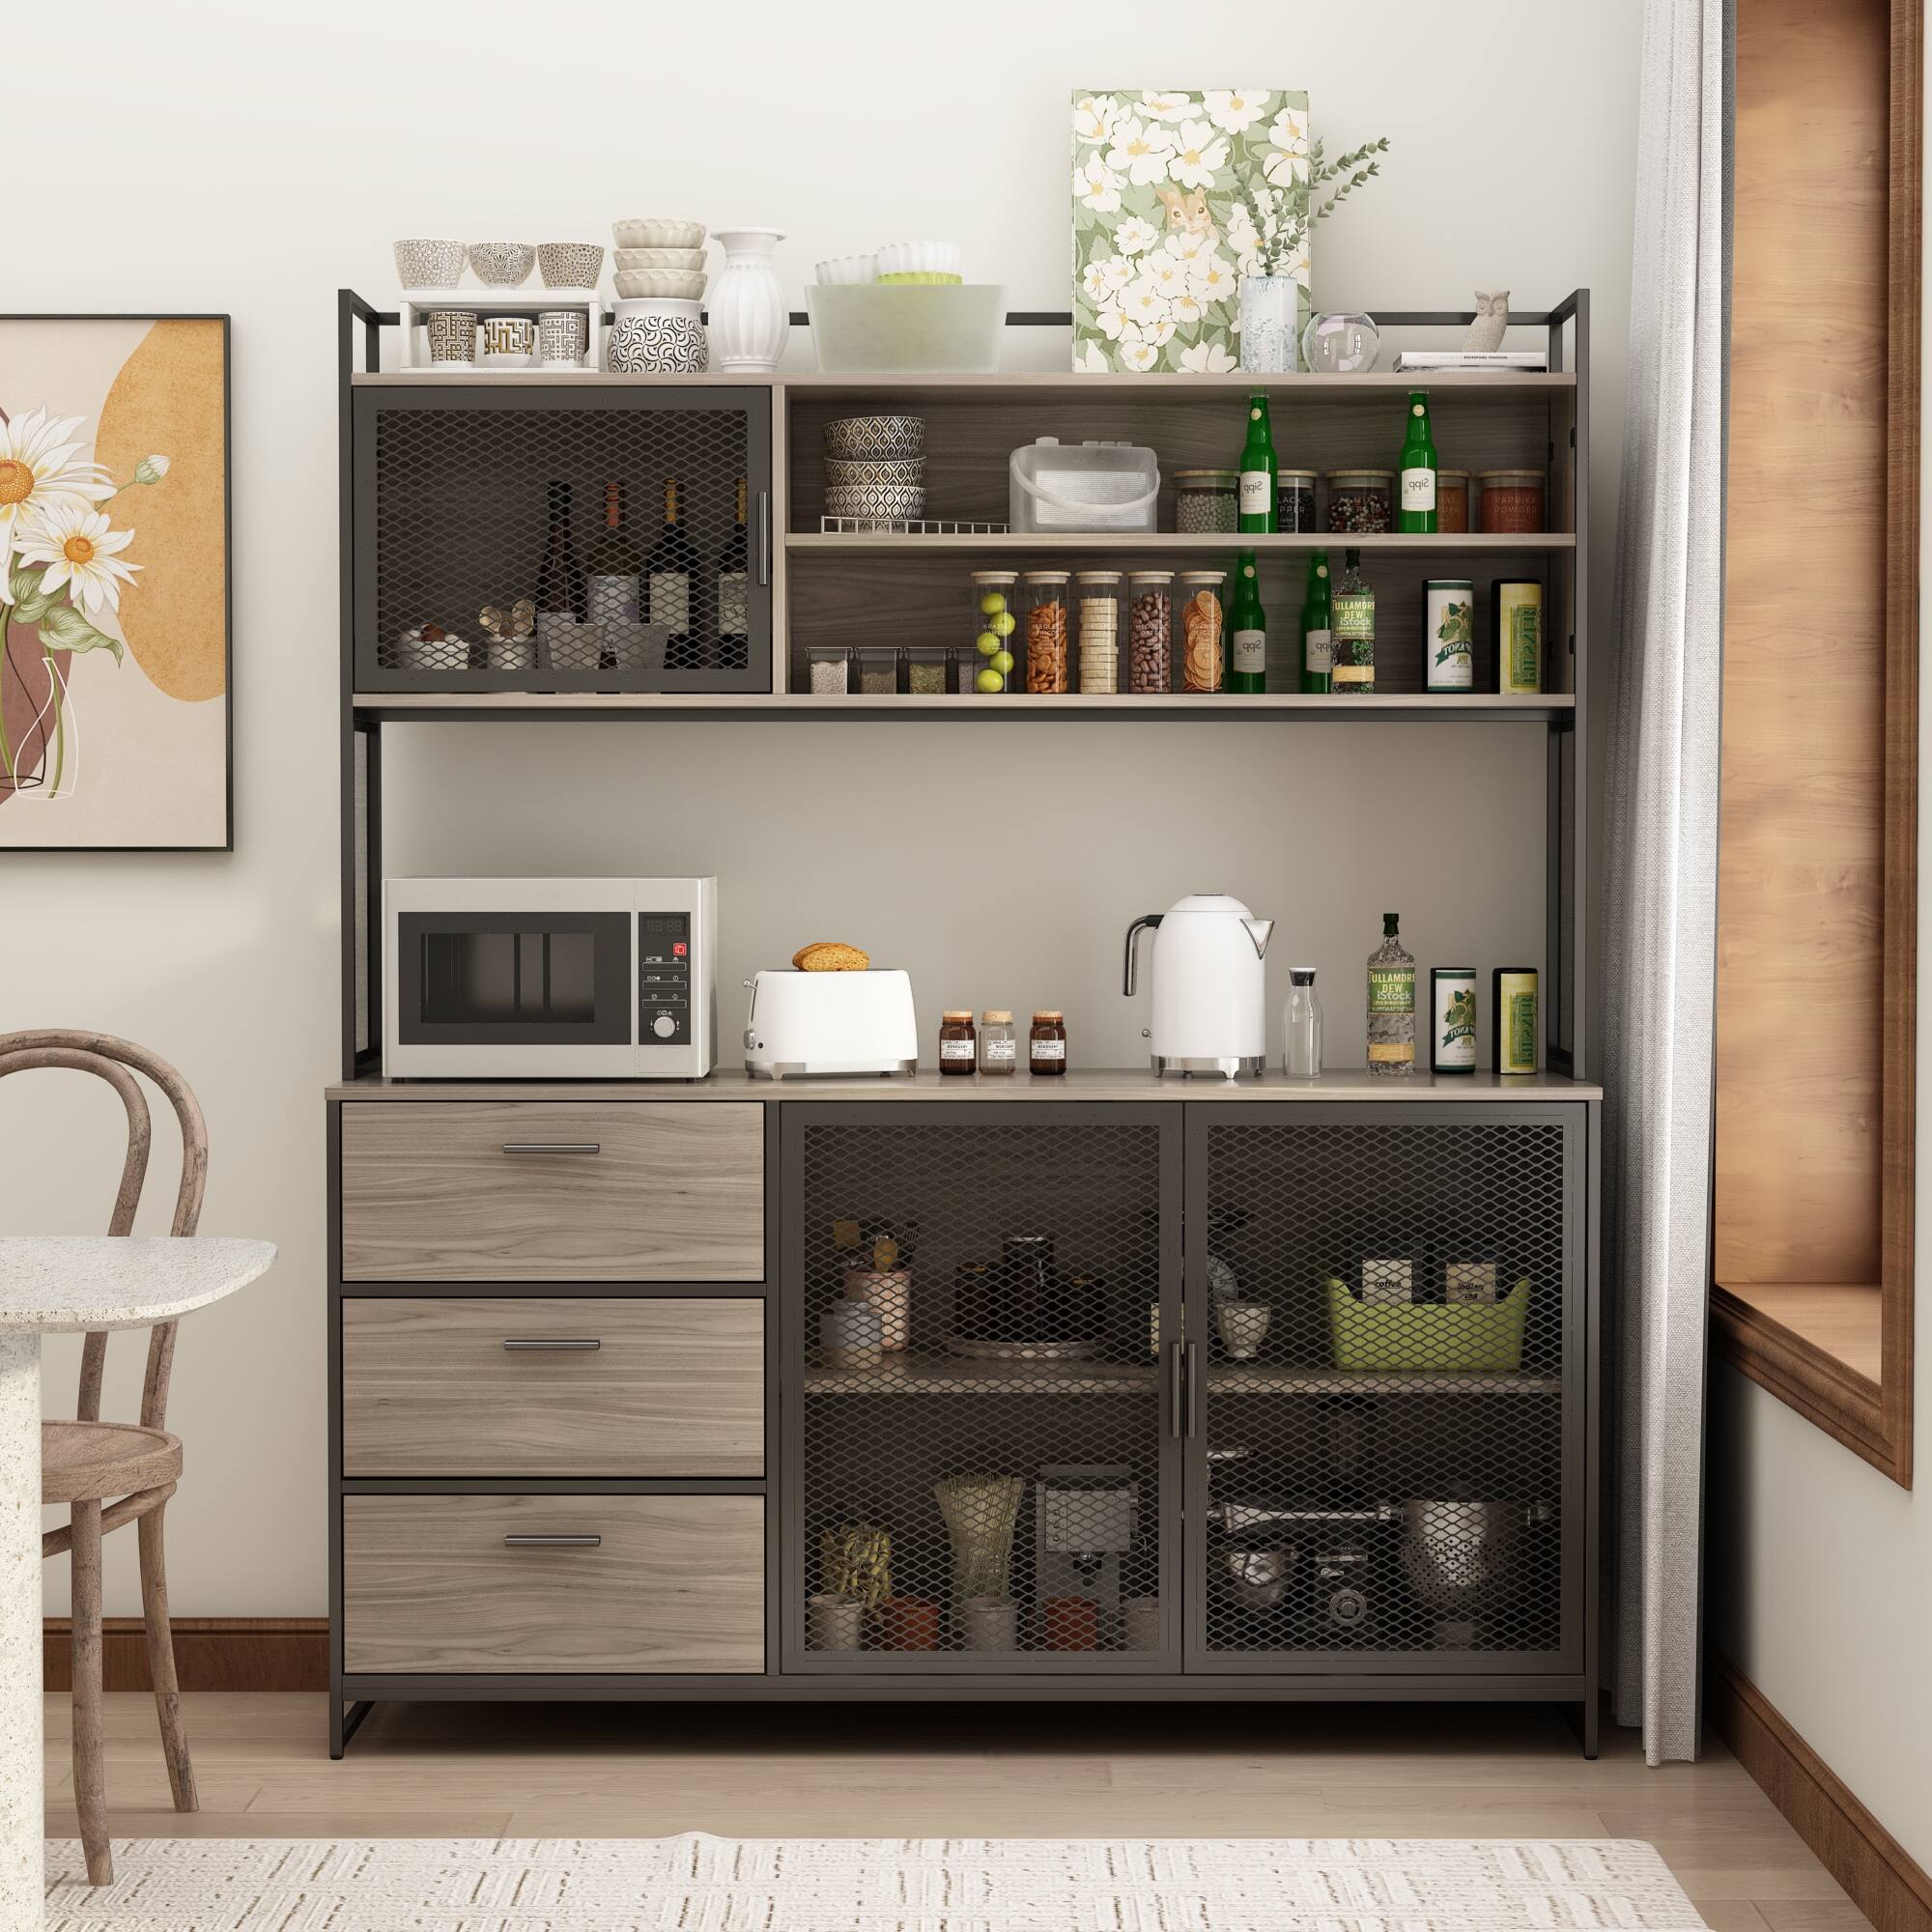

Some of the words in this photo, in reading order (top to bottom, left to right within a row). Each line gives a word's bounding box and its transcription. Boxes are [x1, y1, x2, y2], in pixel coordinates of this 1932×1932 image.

[1344, 611, 1363, 619] DEW
[1381, 983, 1404, 993] DEW
[1377, 990, 1413, 1001] iStock
